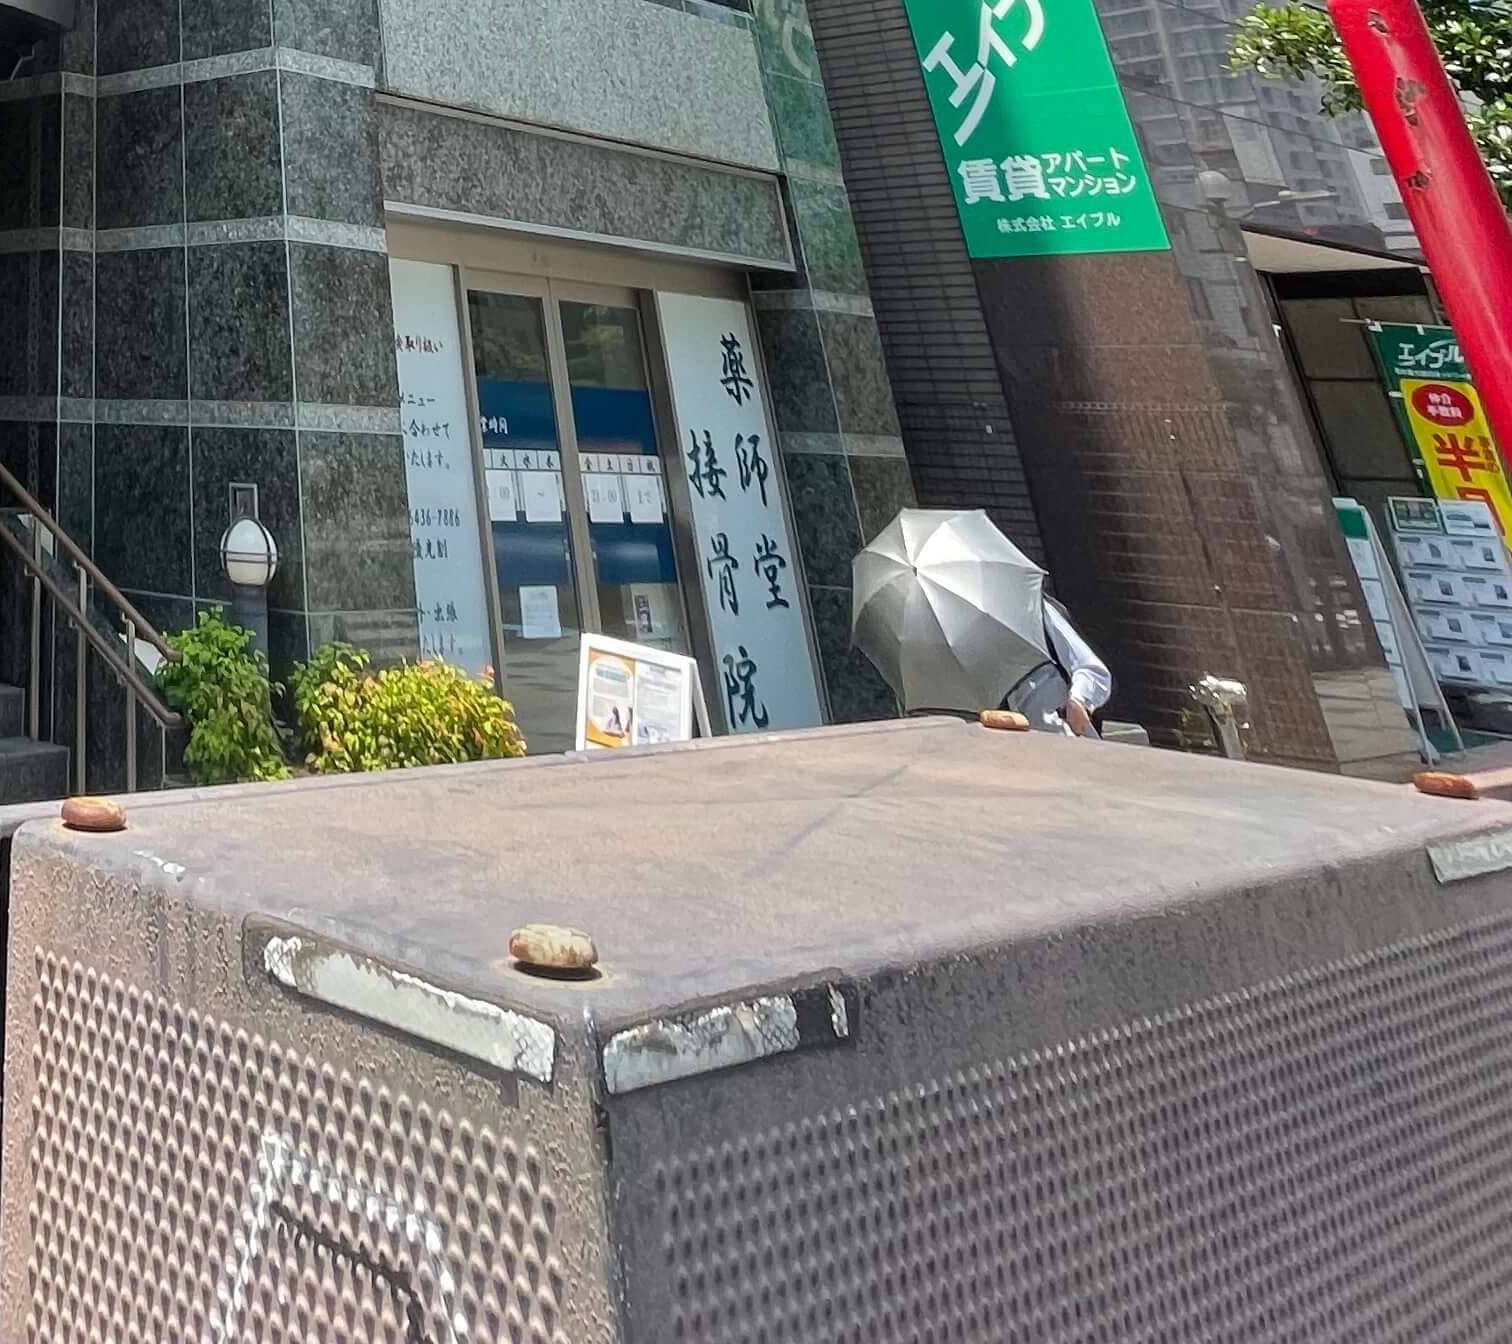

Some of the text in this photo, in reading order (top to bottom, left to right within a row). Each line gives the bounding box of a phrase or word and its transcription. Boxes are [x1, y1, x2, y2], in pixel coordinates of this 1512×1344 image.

[1041, 147, 1129, 175] アパート
[957, 154, 1051, 204] 賃貸
[1048, 172, 1137, 198] マンション
[996, 211, 1121, 234] 株式会社 エイブル
[1398, 340, 1465, 368] エイブル
[719, 332, 790, 609] 薬師堂
[686, 428, 769, 730] 接骨院
